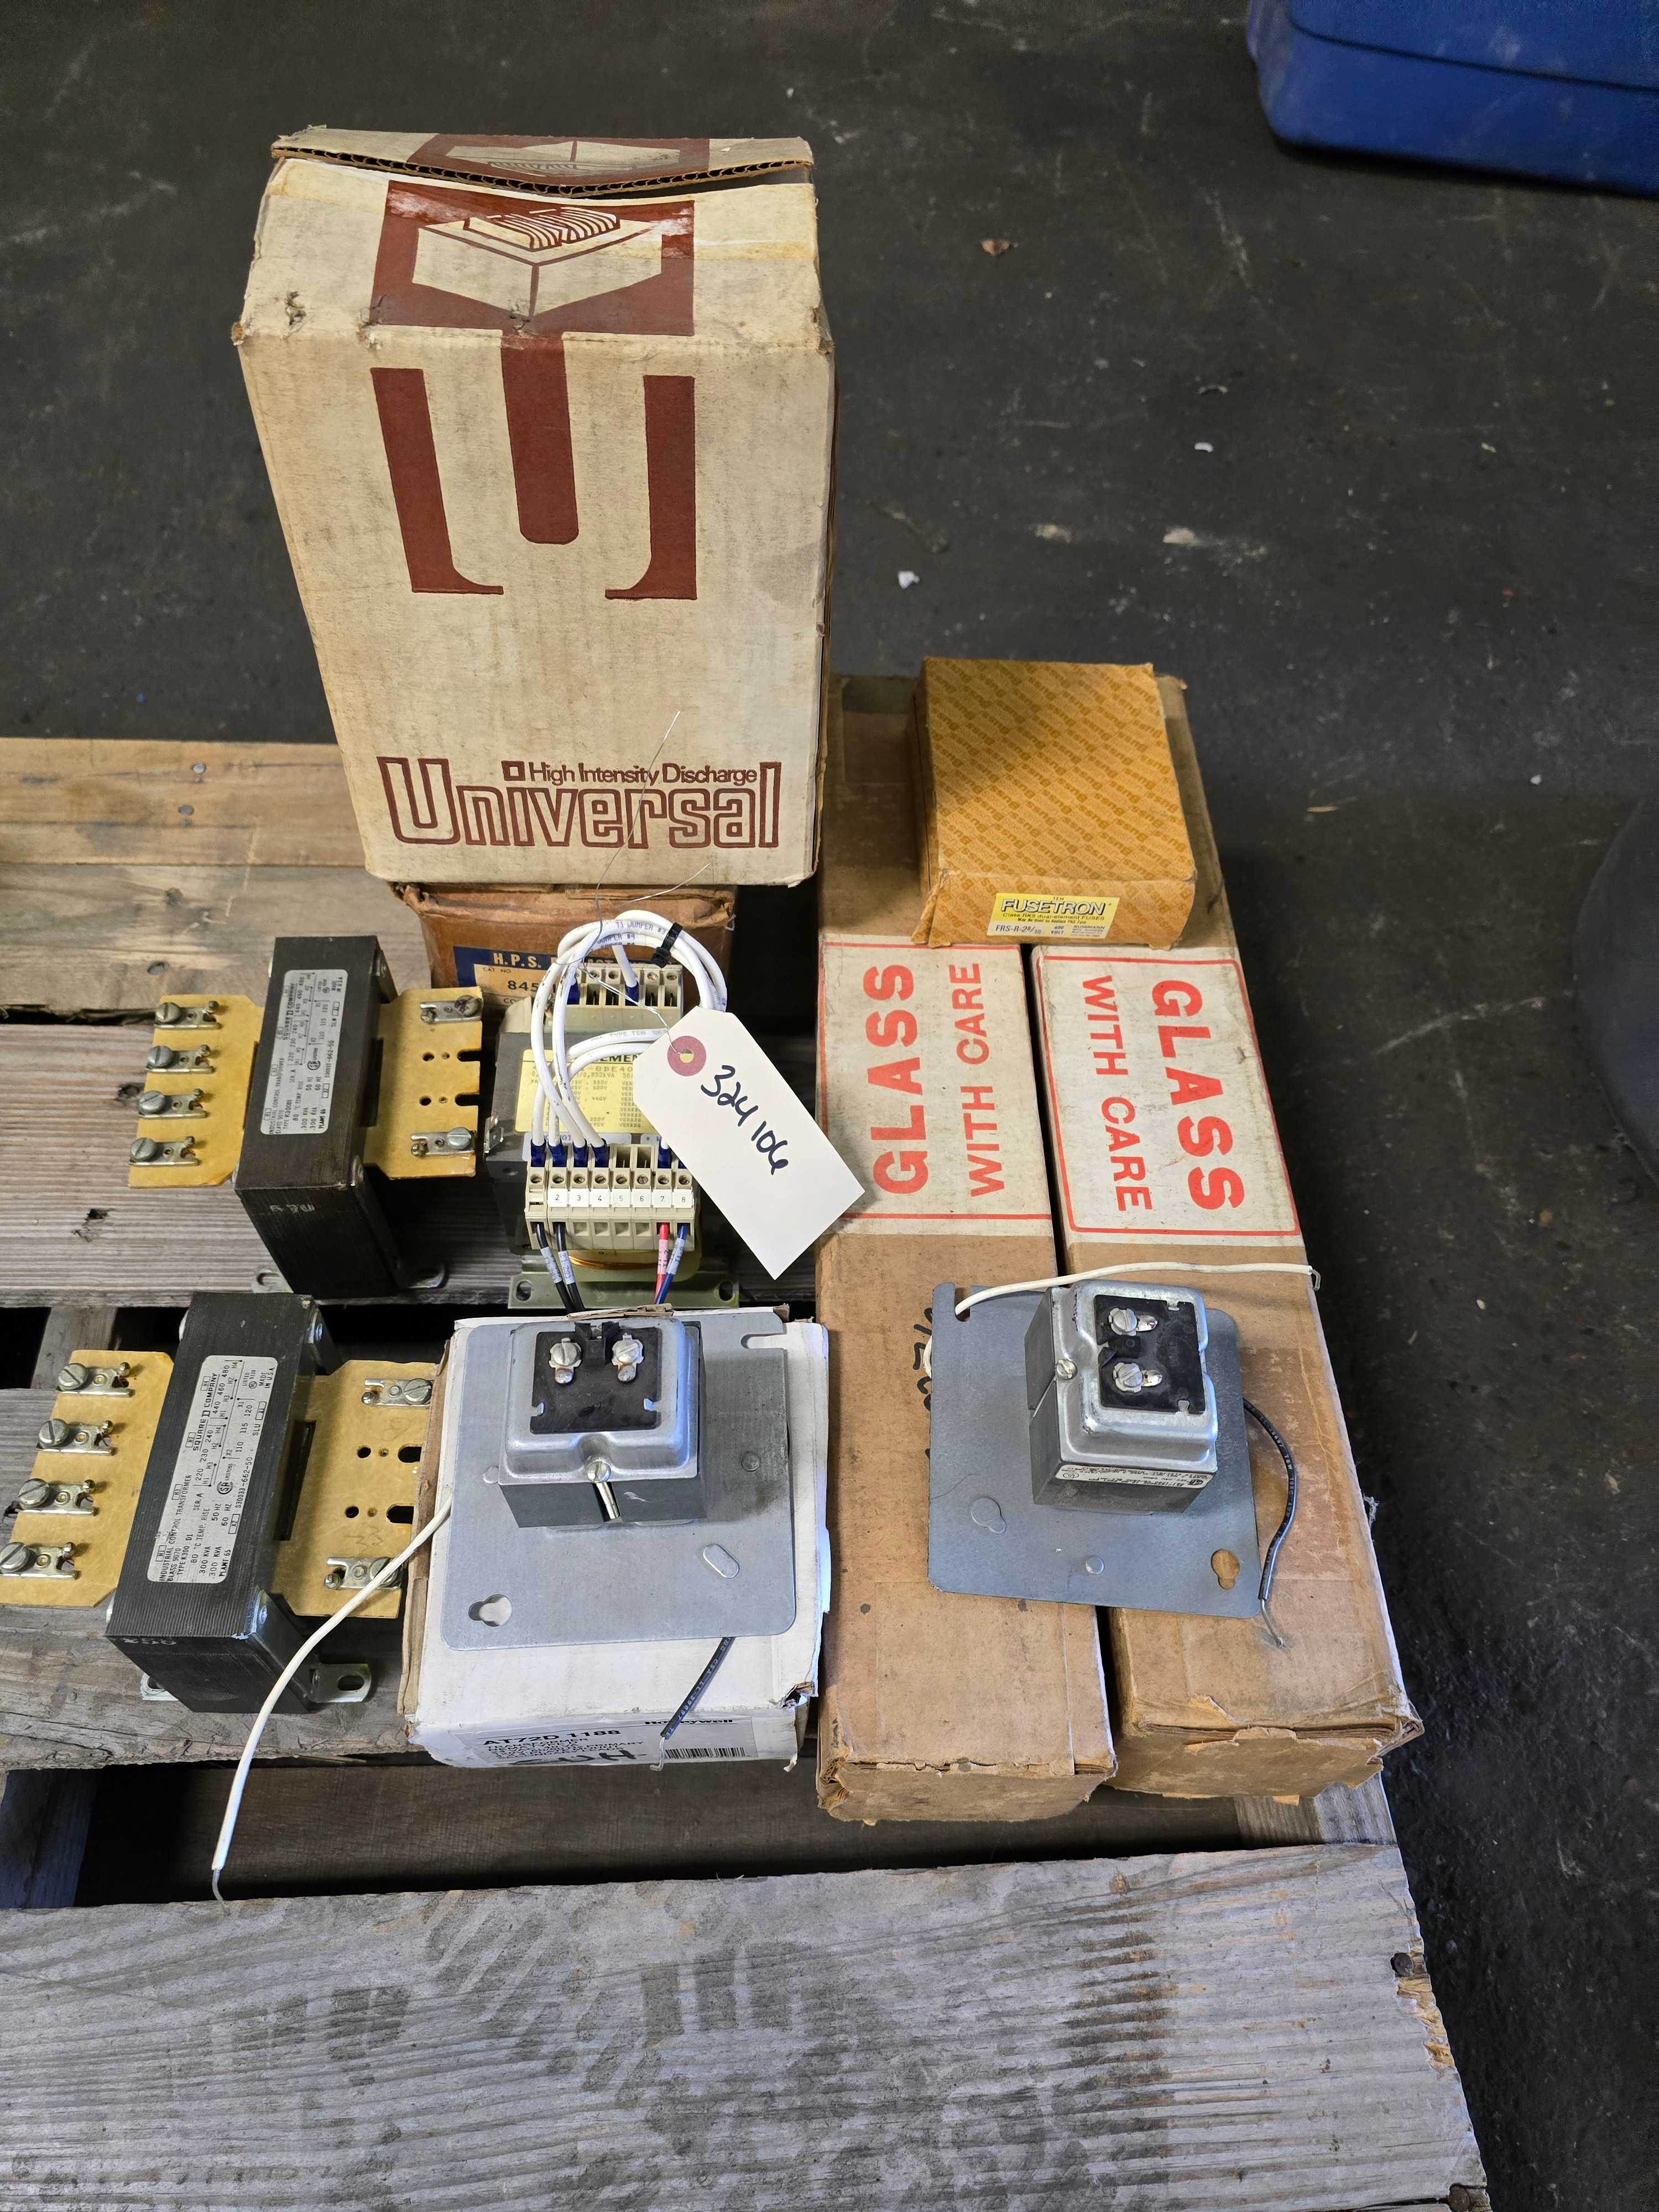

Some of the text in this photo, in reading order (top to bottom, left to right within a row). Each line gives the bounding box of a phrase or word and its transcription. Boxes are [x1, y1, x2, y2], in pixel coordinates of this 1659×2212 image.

[528, 761, 757, 786] High Intensity Discharge
[376, 756, 782, 849] Universal
[628, 921, 653, 931] JUMPER
[1001, 899, 1106, 915] FUSETRON
[493, 953, 541, 968] H.P.S.
[1082, 975, 1129, 1077] WITH
[863, 964, 929, 1194] GLASS
[949, 962, 1005, 1198] WITH CARE
[1151, 979, 1245, 1211] GLASS
[1100, 1096, 1153, 1212] CARE
[212, 1365, 229, 1413] 440 460 480
[258, 1372, 267, 1386] MADE
[192, 1419, 206, 1451] SQUARE
[204, 1373, 218, 1407] COMPANY
[235, 1442, 243, 1452] 110
[244, 1405, 252, 1416] 120
[195, 1430, 213, 1480] 220 230 240
[158, 1475, 192, 1580] INDUSTRIAL CONTROL TRANSFORMER
[193, 1499, 201, 1510] SER.
[172, 1548, 181, 1561] 9070
[190, 1554, 199, 1563] 80
[196, 1523, 206, 1540] TEMP.
[201, 1508, 210, 1520] RISE
[202, 1546, 211, 1557] KVA
[211, 1512, 219, 1521] 50
[213, 1546, 221, 1557] KVA
[221, 1517, 228, 1526] 60
[176, 1561, 186, 1575] TYPE
[484, 1735, 559, 1745] AT72D
